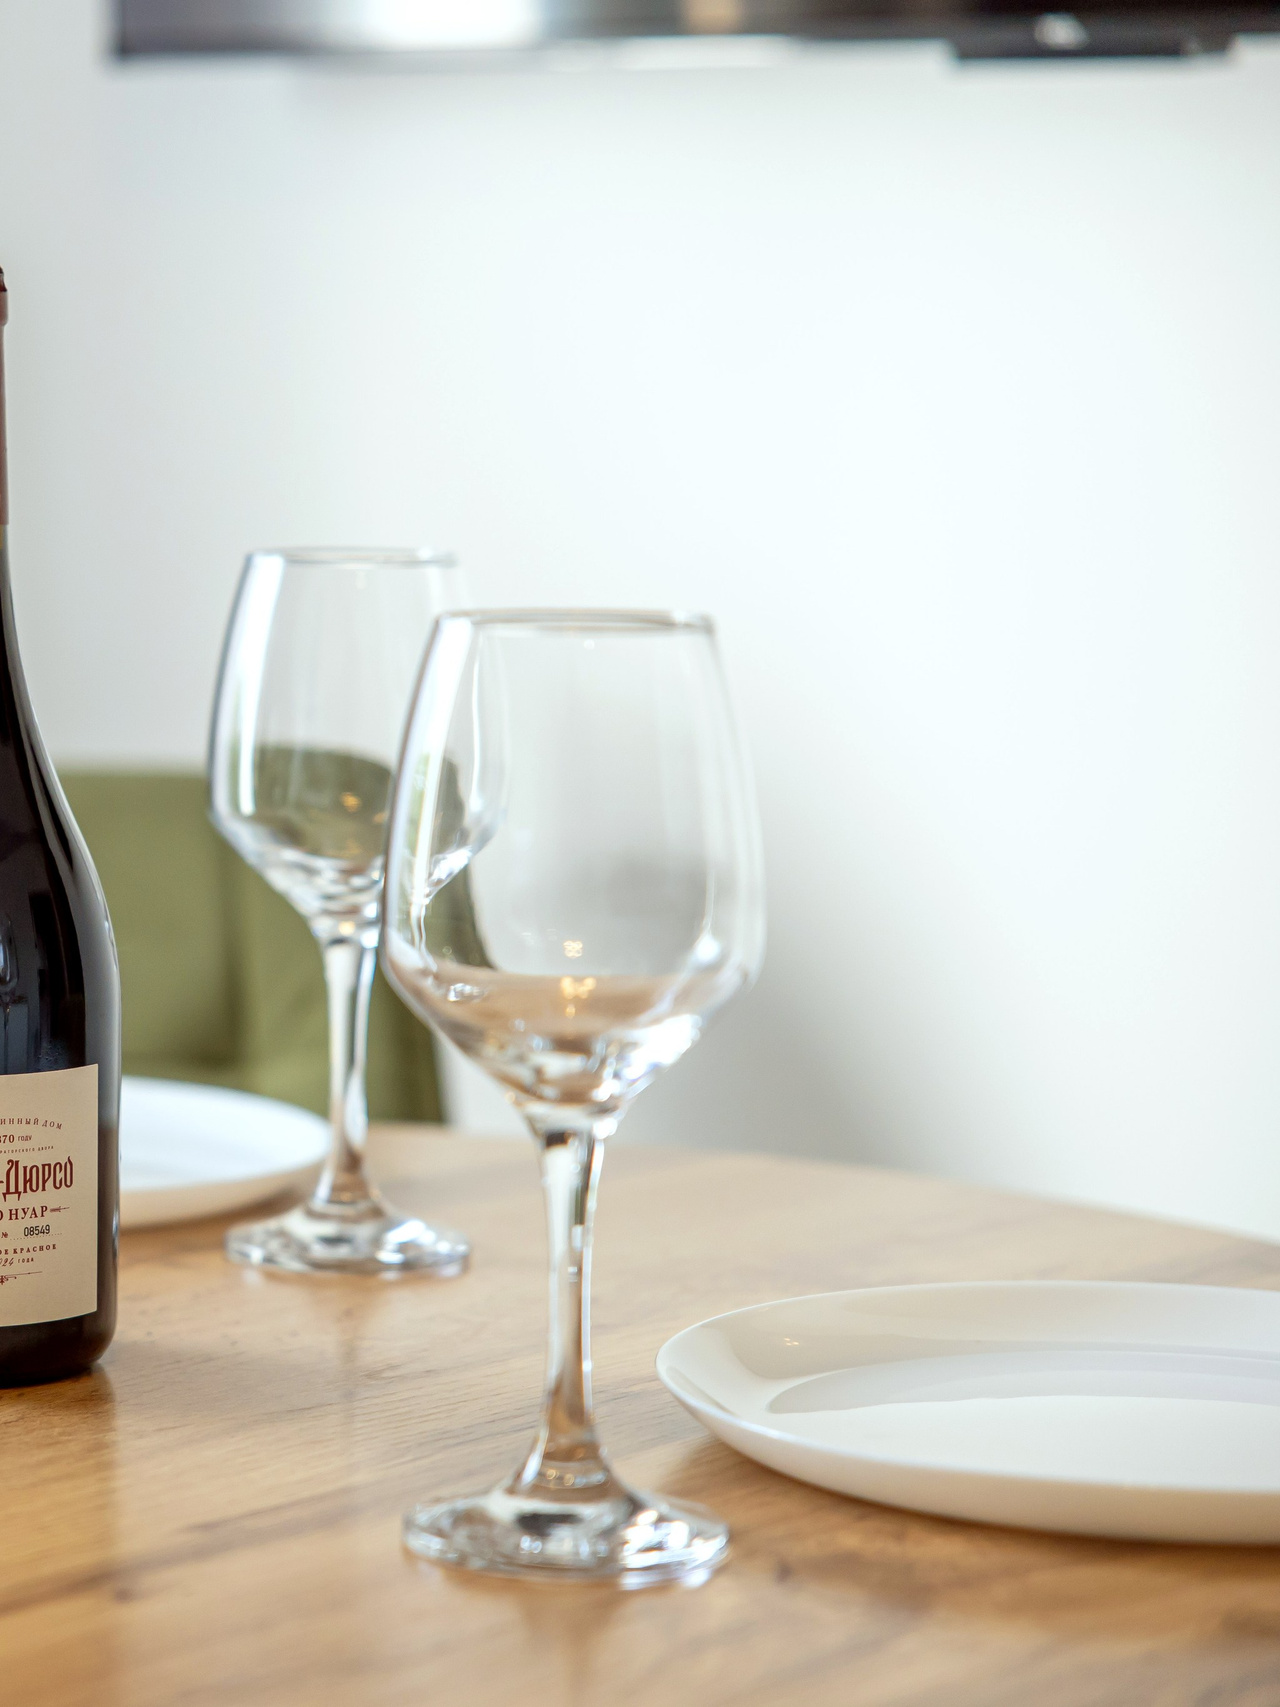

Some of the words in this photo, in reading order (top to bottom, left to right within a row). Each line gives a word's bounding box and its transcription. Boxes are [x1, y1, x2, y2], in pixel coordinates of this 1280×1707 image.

[41, 1119, 63, 1130] ДОМ
[8, 1205, 48, 1221] НУАР
[23, 1224, 51, 1237] 08549
[12, 1243, 57, 1255] КРАСНОЕ
